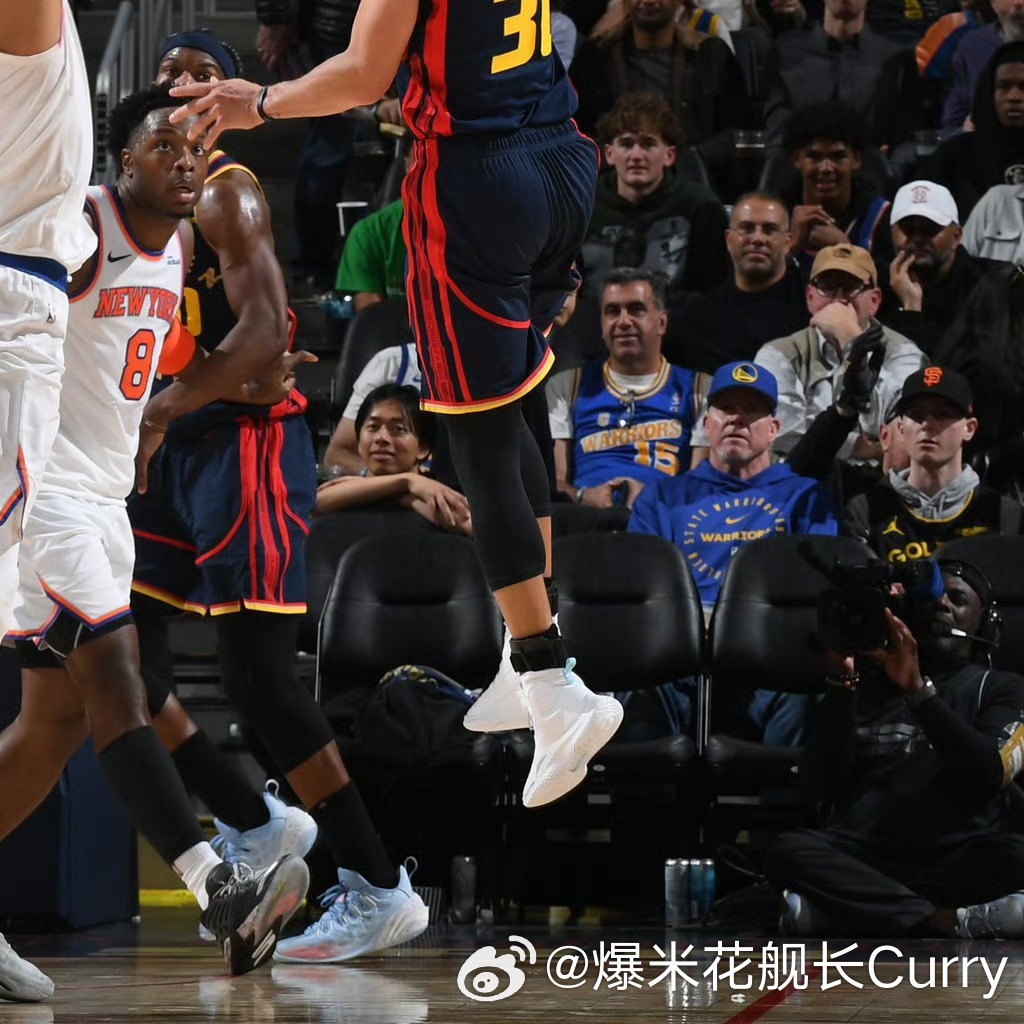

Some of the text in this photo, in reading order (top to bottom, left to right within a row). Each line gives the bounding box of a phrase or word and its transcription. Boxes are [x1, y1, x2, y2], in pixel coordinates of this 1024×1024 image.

[93, 286, 148, 318] NEW
[119, 328, 156, 400] 8
[580, 418, 682, 453] WARRIORS
[634, 441, 680, 476] 15
[887, 541, 946, 565] GOL
